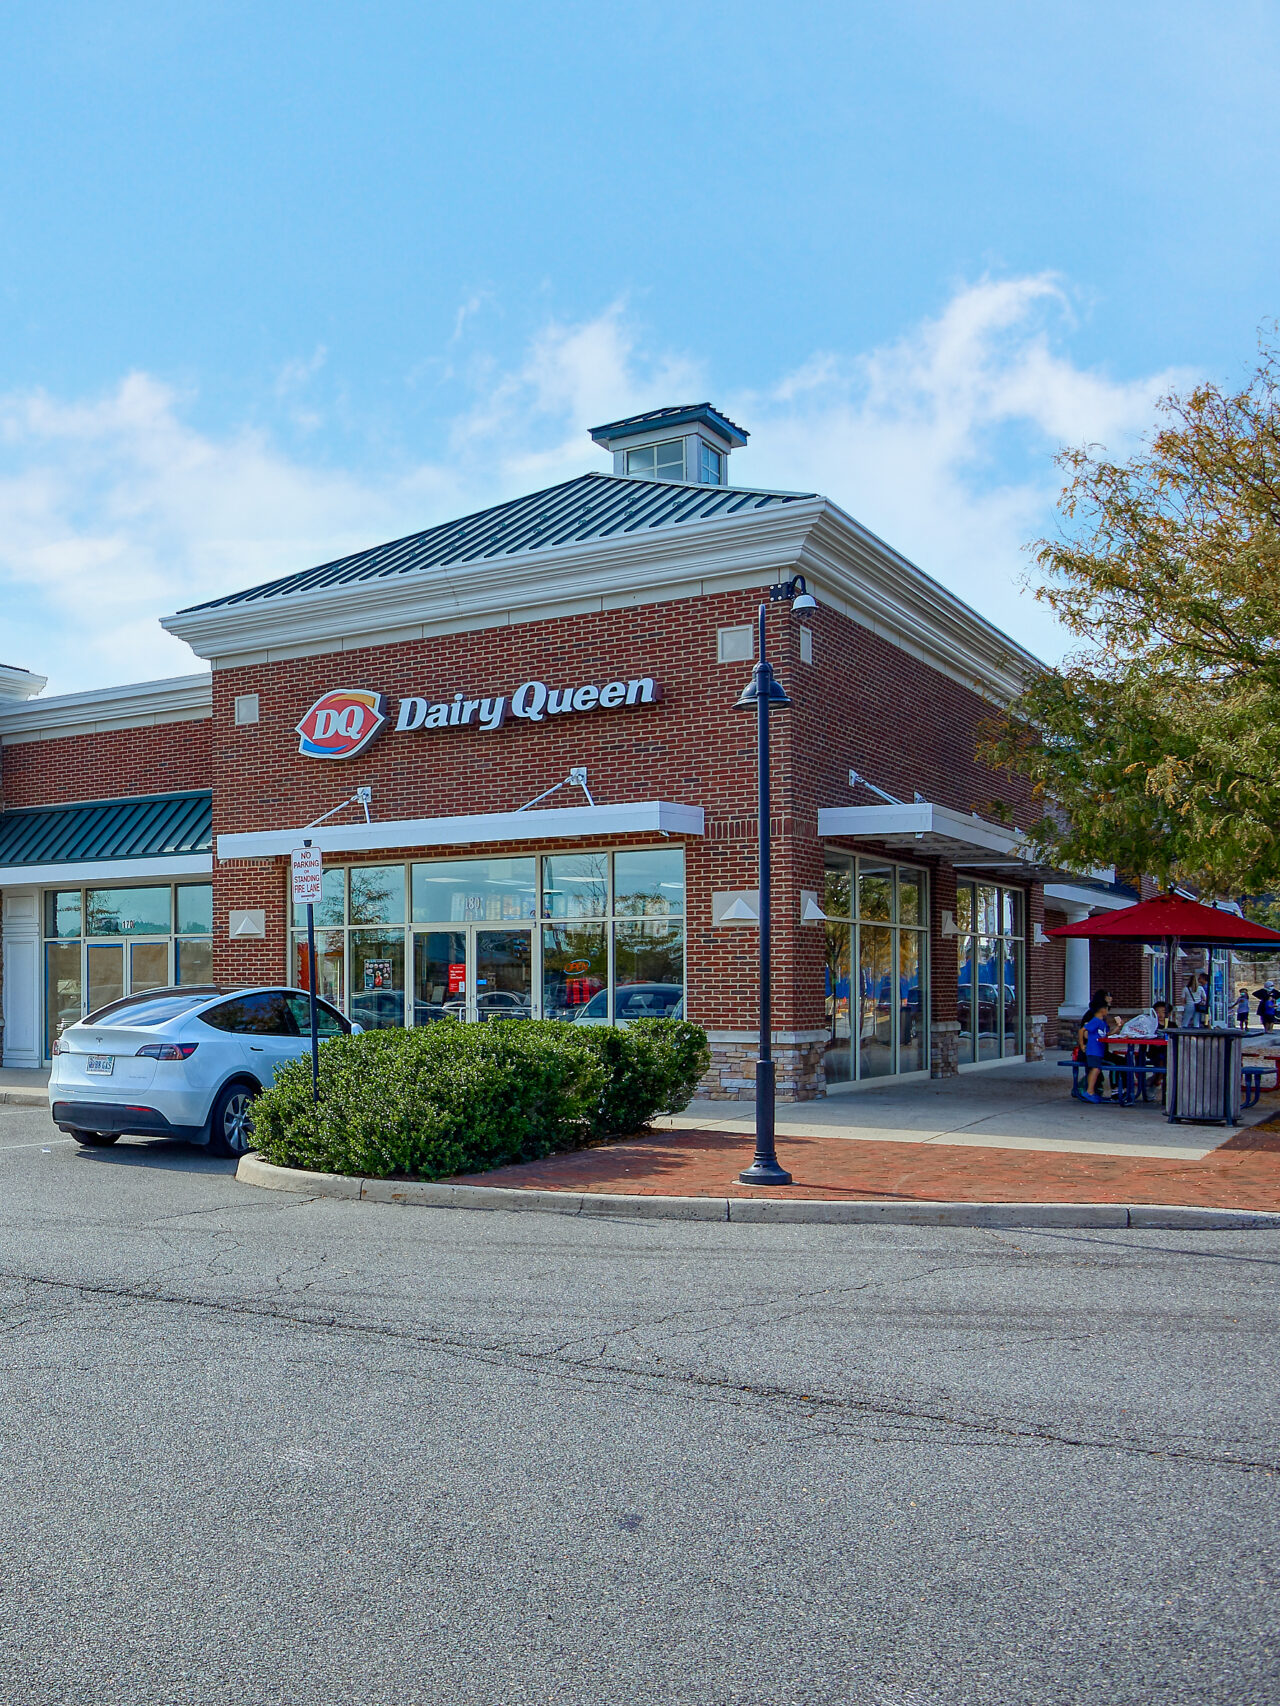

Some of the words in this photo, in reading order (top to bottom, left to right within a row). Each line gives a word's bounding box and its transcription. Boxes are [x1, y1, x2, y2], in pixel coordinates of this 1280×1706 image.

[394, 693, 506, 732] Dairy
[510, 677, 656, 721] Queen
[312, 705, 365, 740] DQ
[301, 851, 311, 859] NO
[294, 860, 319, 868] PARKING
[294, 875, 319, 883] STANDING
[295, 885, 305, 893] FIRE
[307, 883, 320, 892] LANE
[122, 919, 135, 929] 170
